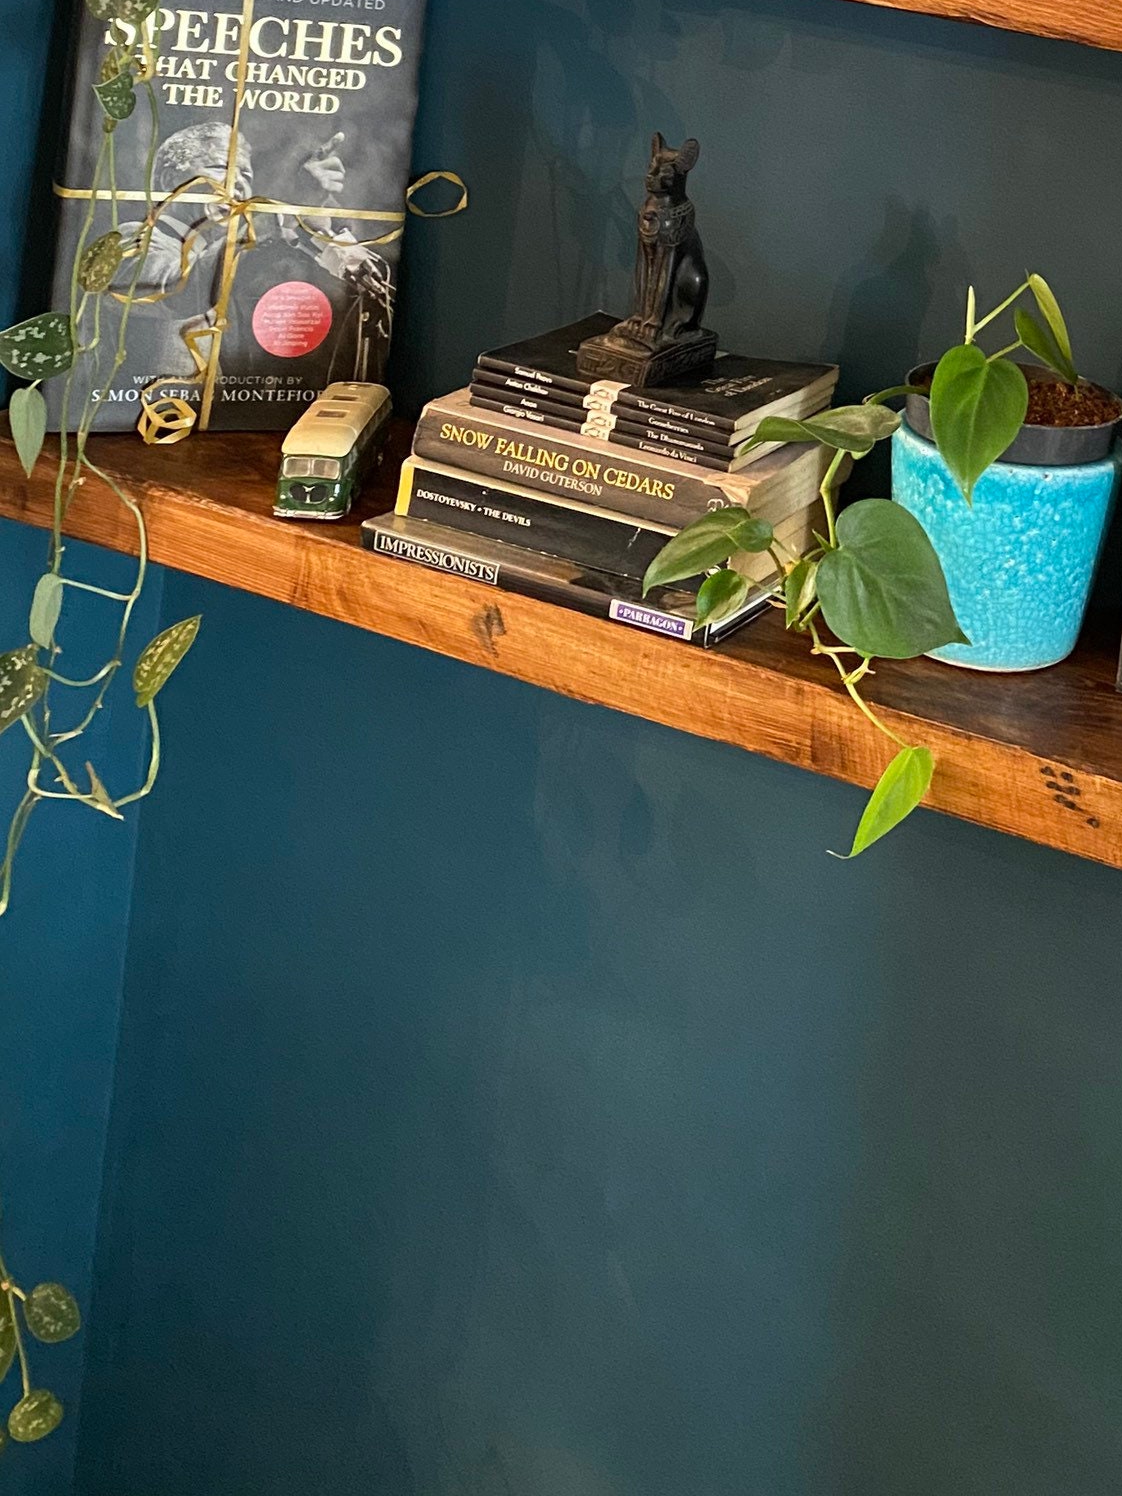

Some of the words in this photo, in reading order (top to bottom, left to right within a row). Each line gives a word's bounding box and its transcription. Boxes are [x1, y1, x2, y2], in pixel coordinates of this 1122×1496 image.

[104, 7, 403, 67] SPEECHES
[162, 82, 224, 108] THE
[233, 87, 340, 115] WORLD
[440, 422, 495, 451] SNOW
[495, 437, 570, 472] FALLING
[571, 458, 602, 480] ON
[603, 467, 677, 501] CEDARS
[503, 460, 540, 480] DAVID
[540, 469, 603, 497] GUTERSON
[379, 533, 497, 583] IMPRESSIONISTS
[622, 608, 678, 631] PARRAGON
